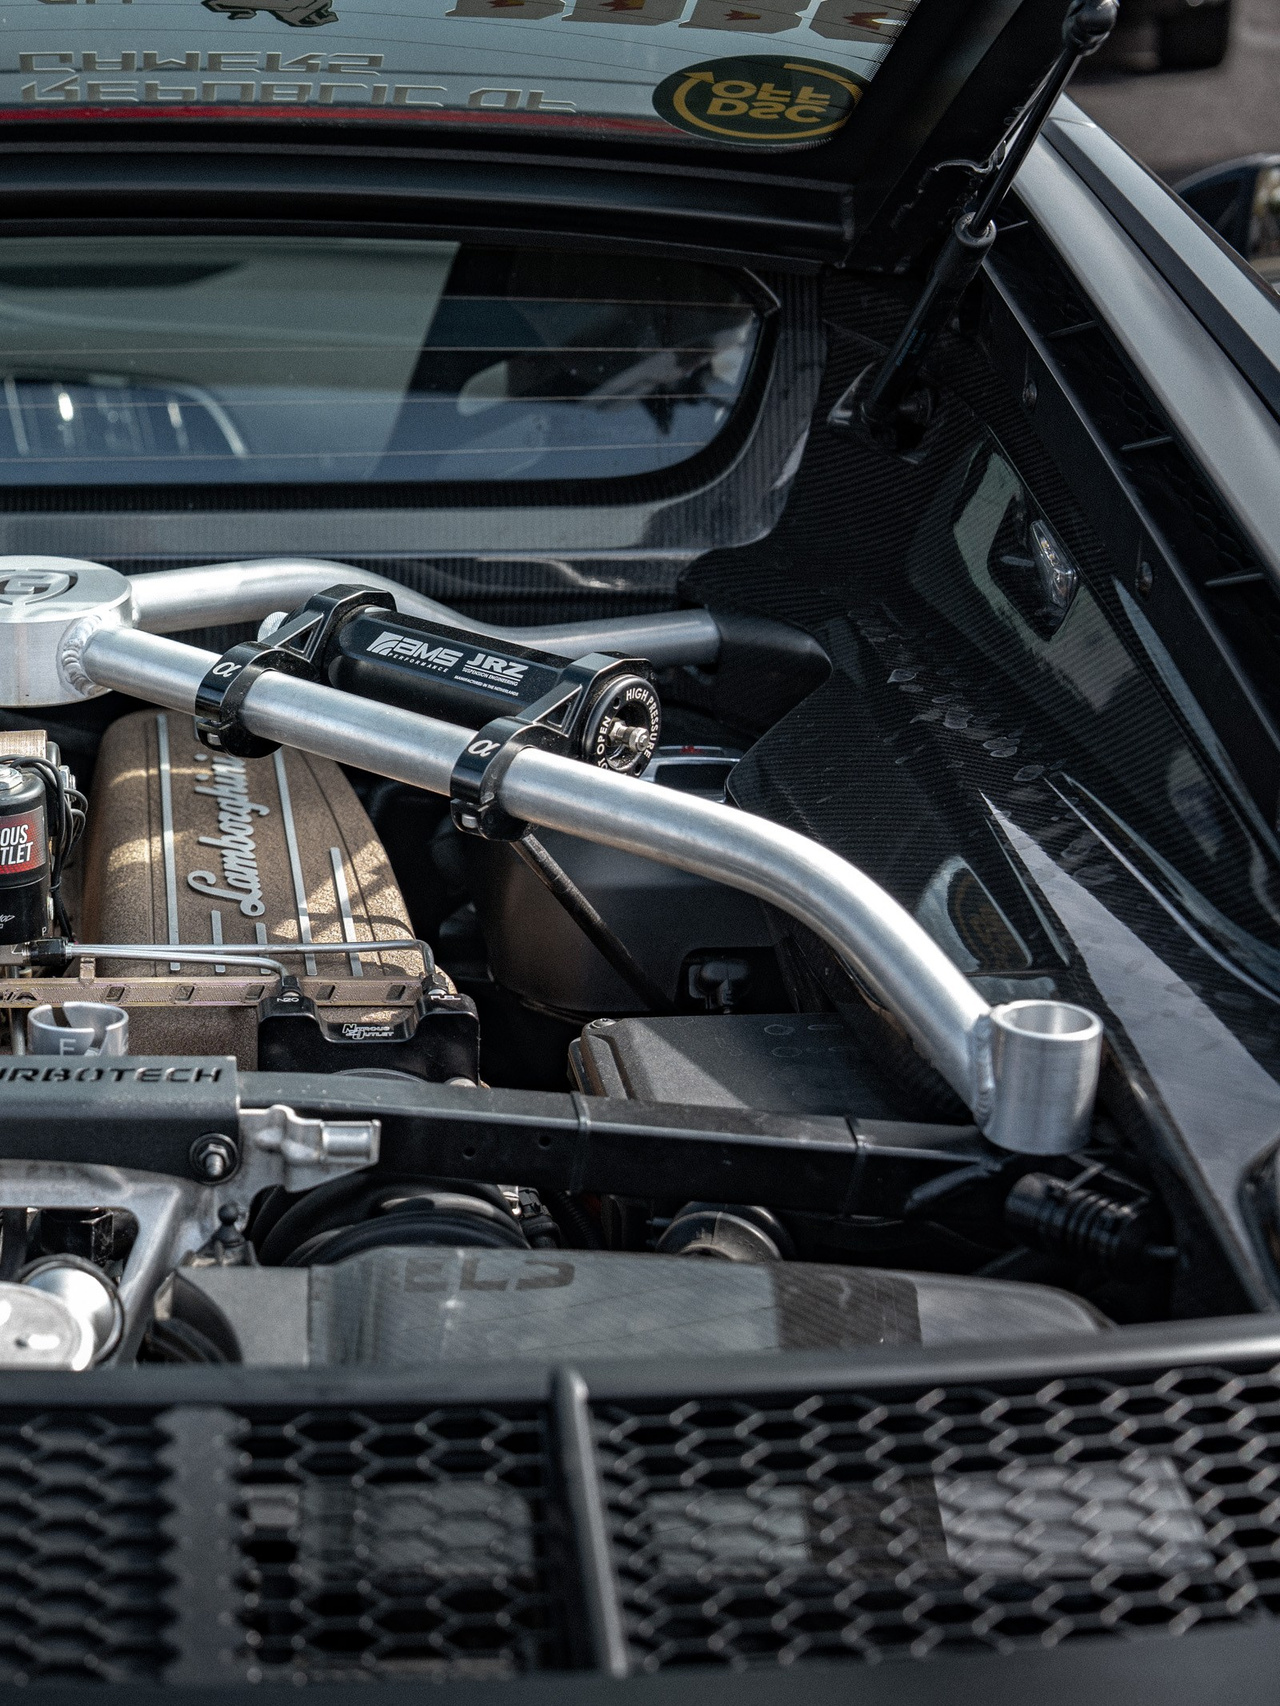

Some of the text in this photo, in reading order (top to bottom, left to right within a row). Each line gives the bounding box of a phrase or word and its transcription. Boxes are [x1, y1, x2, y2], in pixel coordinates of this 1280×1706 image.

[387, 652, 449, 673] PERFORMANCE
[391, 636, 529, 679] AMS JRZ
[597, 716, 611, 755] OPEN
[626, 687, 659, 758] HIGH PRESSURE
[187, 754, 270, 917] Lamborghini
